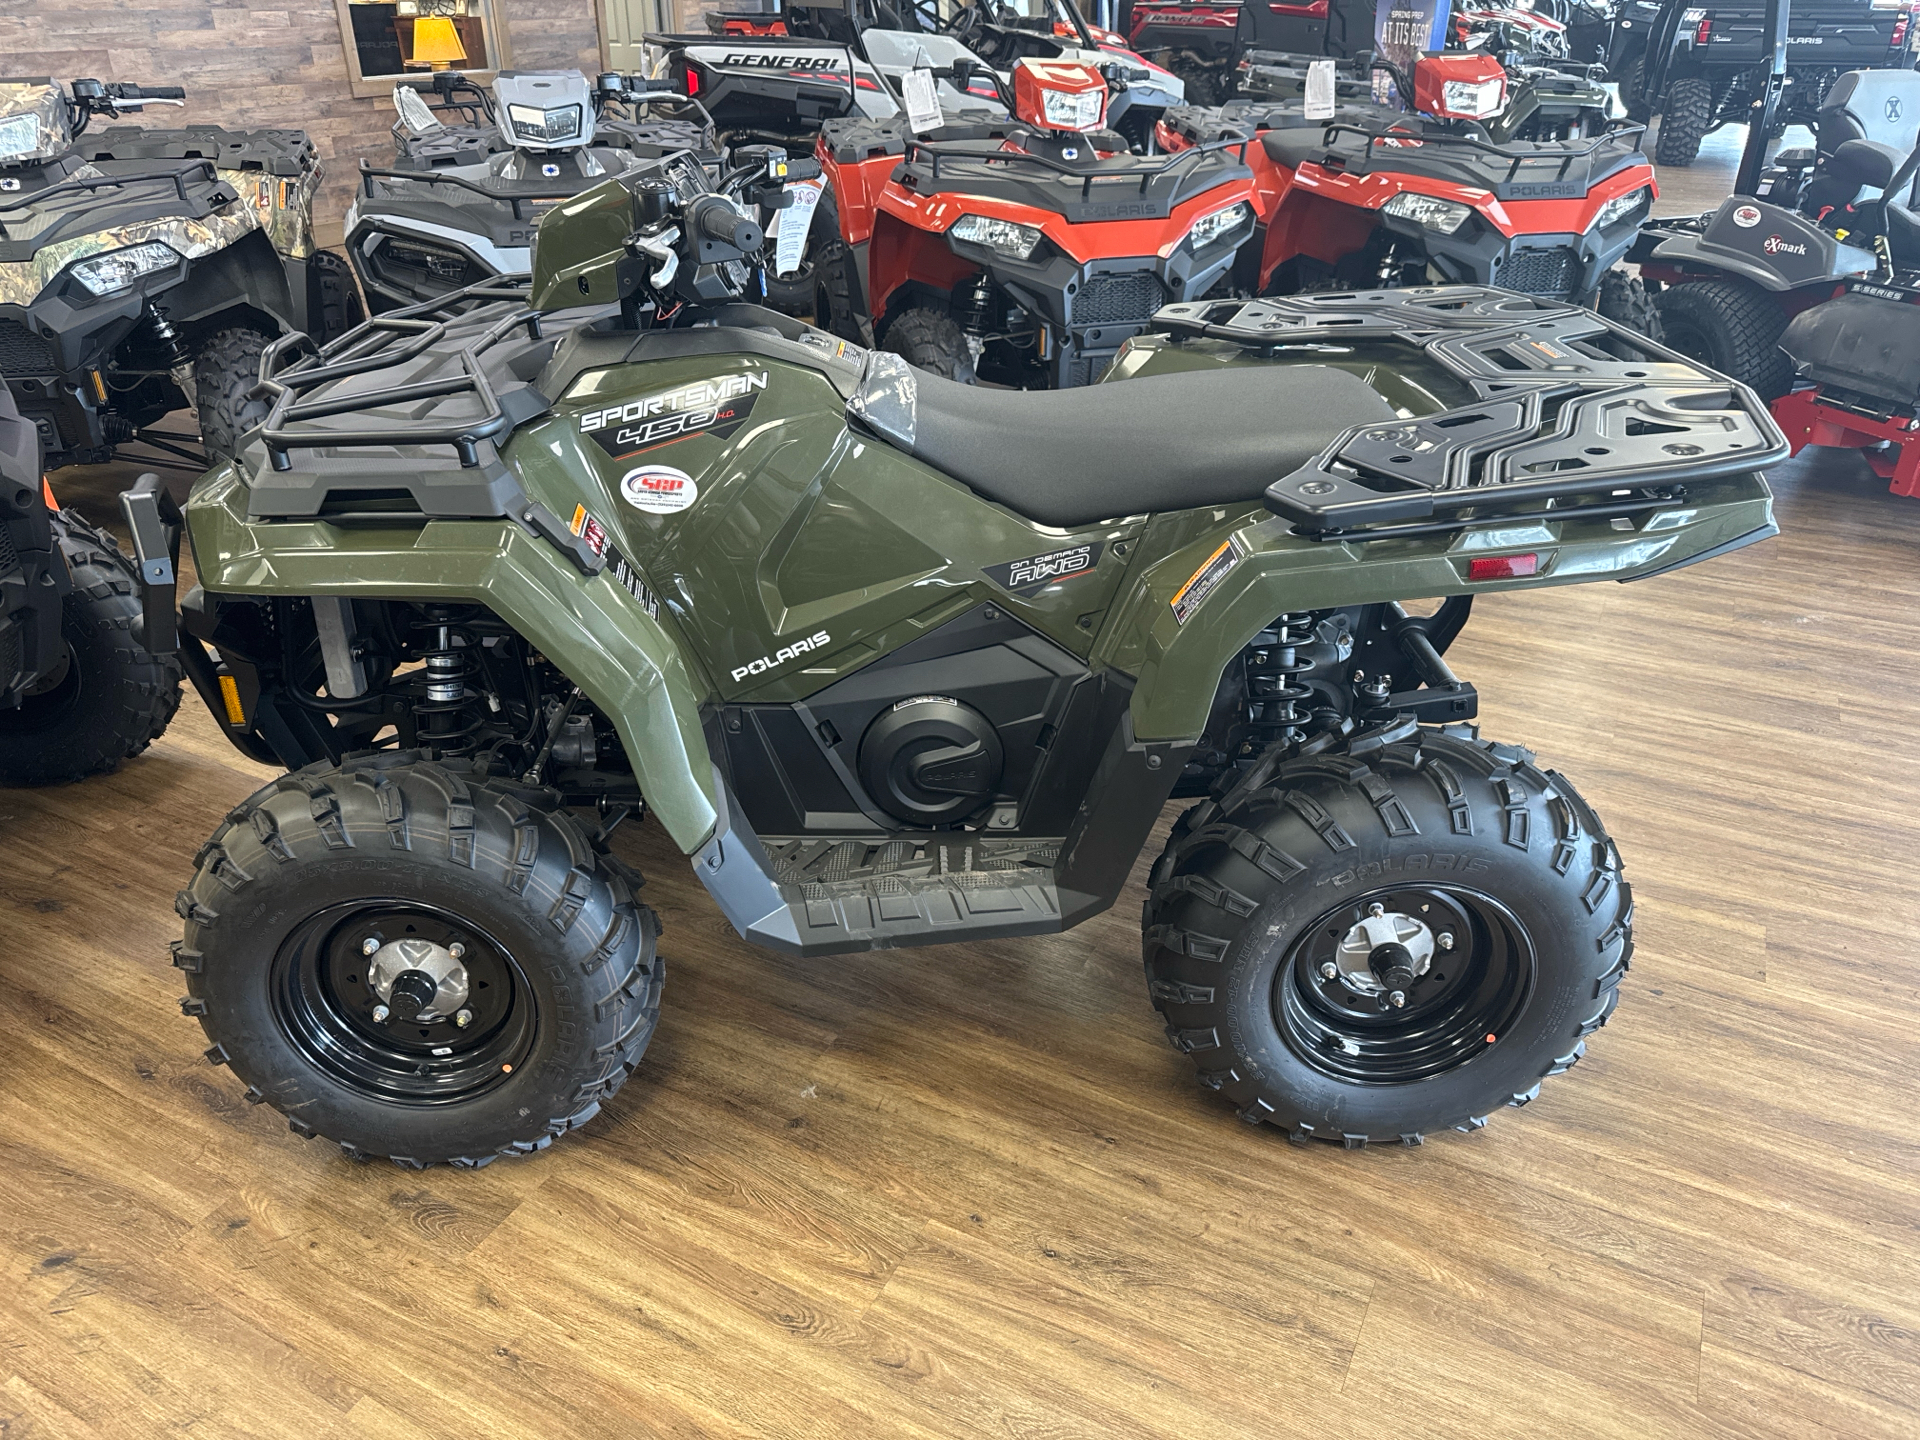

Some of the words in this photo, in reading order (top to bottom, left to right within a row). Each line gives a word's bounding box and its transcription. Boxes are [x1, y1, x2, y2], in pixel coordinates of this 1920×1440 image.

[1391, 10, 1411, 19] SPRING
[1411, 11, 1425, 19] PREP
[1381, 21, 1394, 44] AT
[1394, 22, 1410, 45] ITS
[1410, 23, 1430, 47] BEST
[1785, 36, 1824, 45] OLARIS
[1509, 185, 1576, 196] POLARIS
[1081, 204, 1157, 217] POLARIS
[580, 371, 768, 433] SPORTSMAN
[616, 406, 718, 444] 450
[716, 410, 735, 420] H.O.
[1009, 553, 1090, 586] AWD
[1010, 560, 1030, 570] ON
[1034, 546, 1091, 564] DEMAND
[731, 629, 831, 682] POLARIS
[1331, 853, 1492, 890] POLARIS
